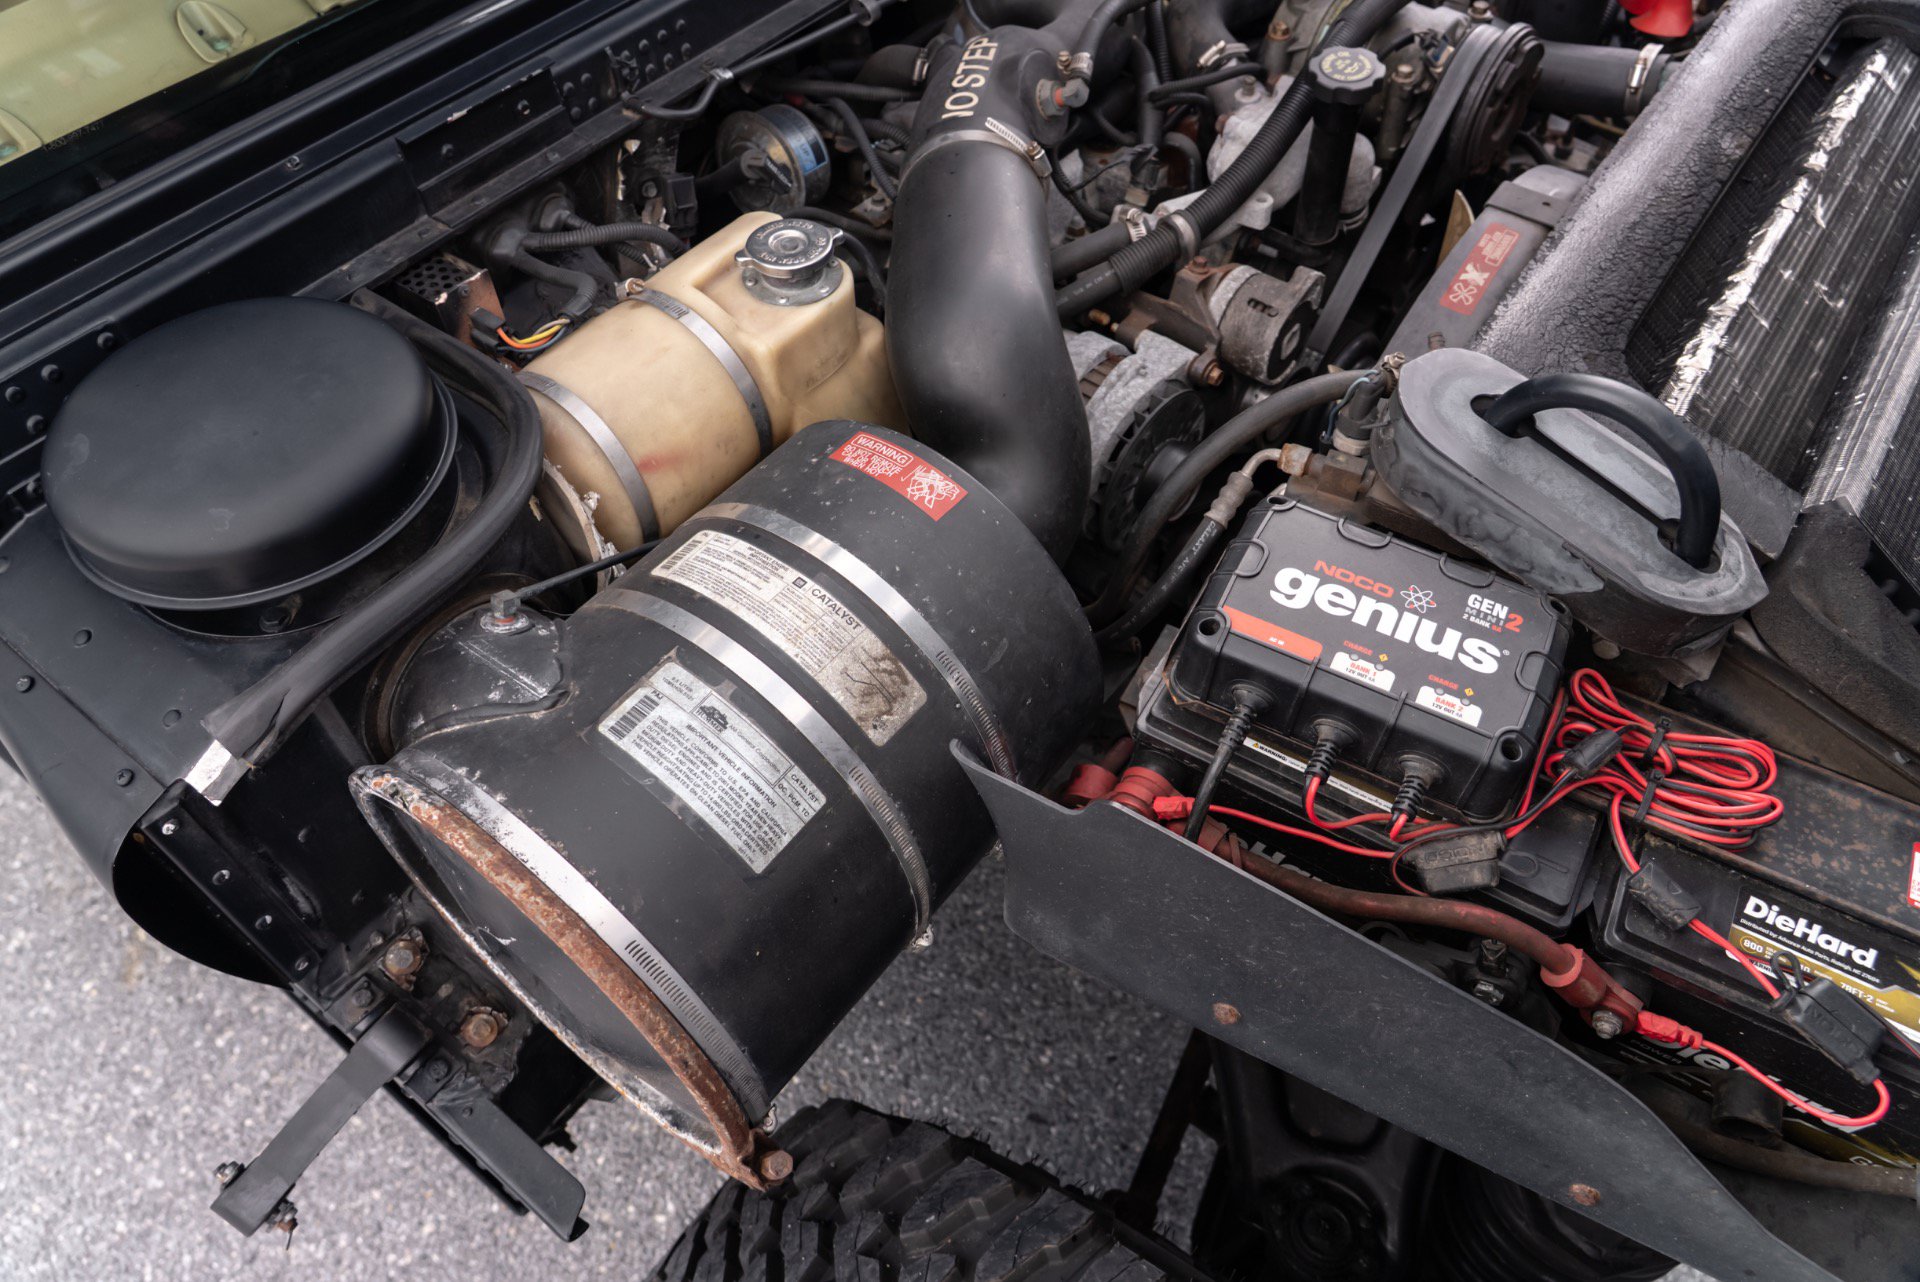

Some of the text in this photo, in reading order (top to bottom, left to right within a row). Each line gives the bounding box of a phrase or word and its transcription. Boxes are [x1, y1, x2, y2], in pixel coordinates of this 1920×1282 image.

[844, 444, 903, 475] DO NOT REMOVE
[856, 436, 909, 465] WARNING
[857, 455, 869, 464] OR
[869, 461, 896, 477] TOUCH
[843, 457, 881, 477] WHEN HOT
[1313, 560, 1395, 598] NOCO
[811, 588, 862, 630] CATALYST
[1269, 567, 1502, 674] genius
[1465, 606, 1504, 627] MINI
[1467, 594, 1524, 633] GEN 2
[1469, 616, 1491, 629] BANK
[1343, 640, 1374, 657] CHARGE
[1350, 662, 1371, 675] BANK
[1428, 674, 1459, 690] CHARGE
[1432, 702, 1442, 710] 12V
[1443, 706, 1455, 715] OUT
[1435, 696, 1457, 710] BANK
[694, 708, 724, 733] HUMMER
[636, 734, 656, 752] VEHICLE
[655, 750, 674, 766] WEIGHT
[671, 762, 694, 783] RATING
[685, 723, 777, 808] IMPORTANT VEHICLE INFORMATION
[736, 730, 756, 749] General
[754, 747, 782, 774] Corporation
[646, 725, 660, 736] DUTY
[660, 734, 677, 750] DIESEL
[677, 749, 700, 770] ENGINES
[699, 768, 712, 780] AND
[717, 784, 742, 809] CERTIFIED
[742, 808, 753, 820] FOR
[752, 818, 763, 830] USE
[767, 835, 778, 846] ALL
[651, 719, 685, 747] REGULATIONS
[683, 745, 712, 771] APPLICABLE
[727, 785, 745, 802] MODEL
[744, 801, 758, 815] YEAR
[755, 813, 768, 825] NEW
[656, 715, 668, 725] THIS
[669, 724, 690, 742] VEHICLE
[690, 742, 718, 767] CONFORMS
[719, 767, 727, 776] TO
[738, 785, 749, 796] EPA
[748, 796, 761, 808] AND
[760, 807, 788, 836] CALIFORNIA
[631, 738, 643, 750] THIS
[642, 747, 663, 766] VEHICLE
[662, 764, 690, 789] OPERATES
[688, 787, 698, 796] ON
[696, 794, 715, 811] CLEAN
[713, 810, 731, 827] DIESEL
[730, 827, 743, 840] FUEL
[674, 755, 686, 766] AND
[716, 793, 740, 817] VEHICLES
[739, 816, 753, 829] WITH
[756, 833, 773, 852] GROSS
[789, 773, 819, 803] CATALYST
[786, 793, 802, 809] PCM,
[800, 807, 810, 817] TC
[1739, 918, 1769, 934] Distributed
[1777, 934, 1801, 948] Advance
[1800, 945, 1814, 954] Auto
[1743, 895, 1878, 970] DieHard
[1743, 938, 1763, 953] 800
